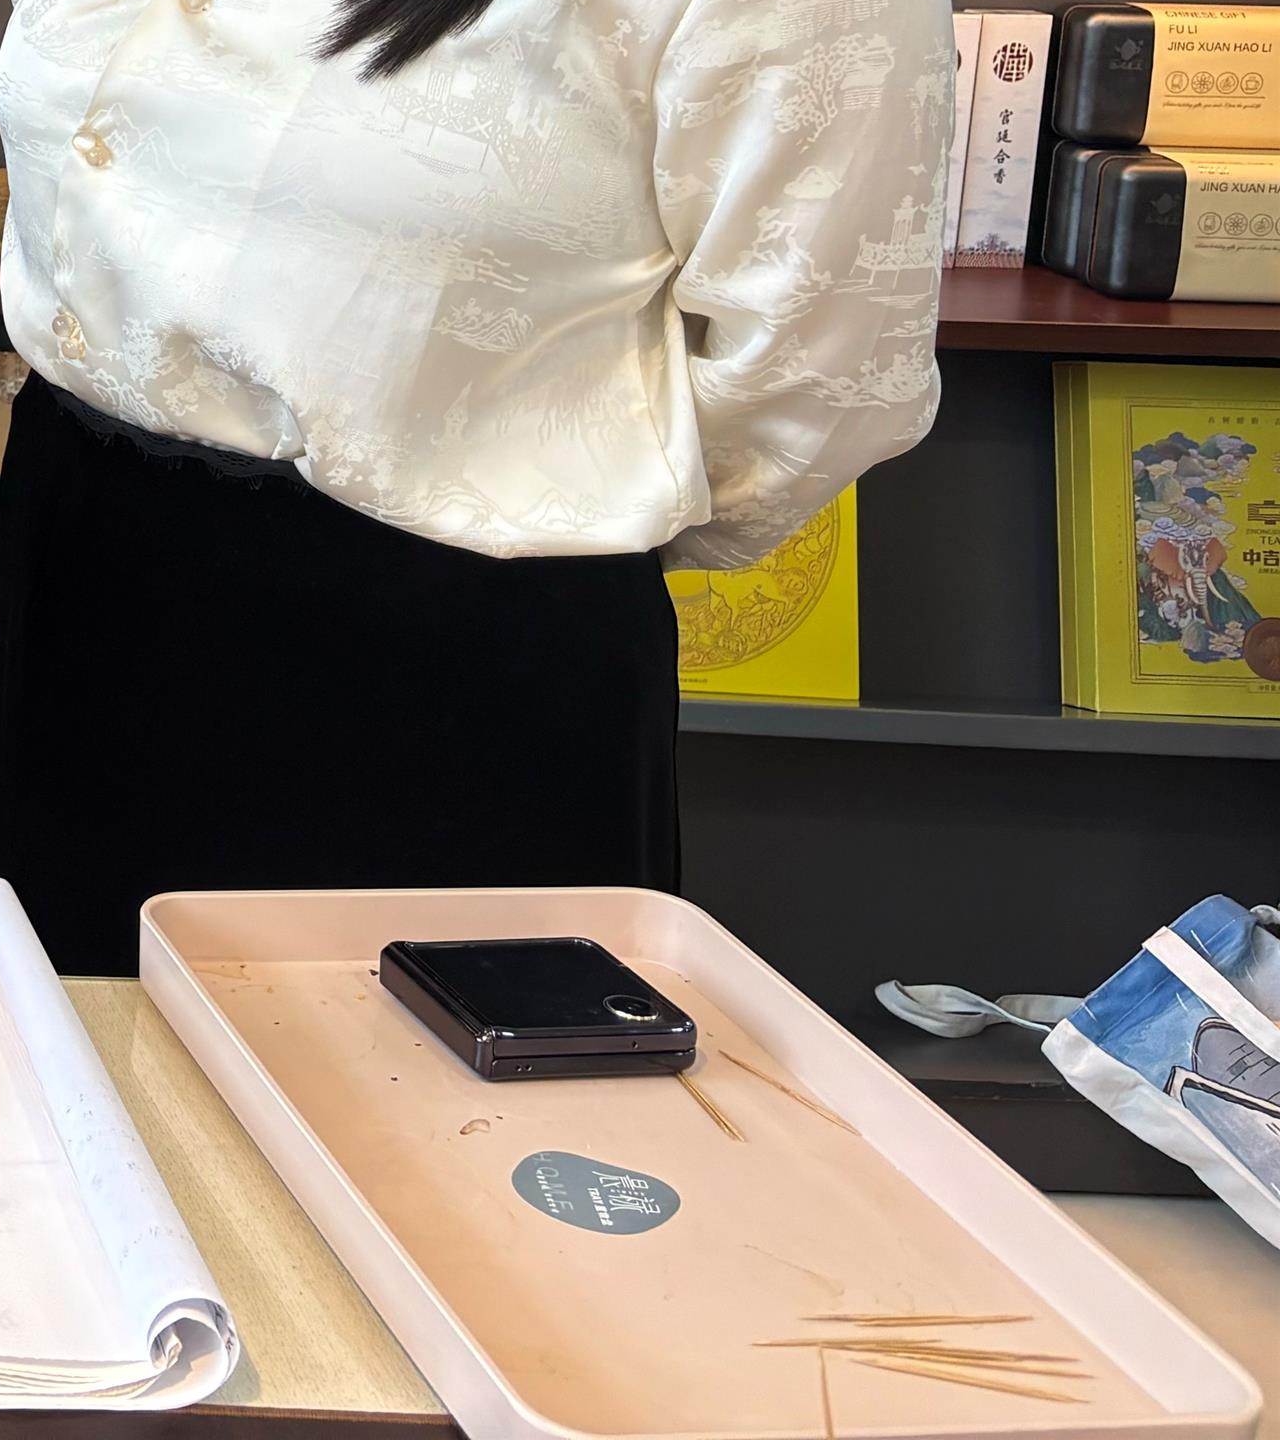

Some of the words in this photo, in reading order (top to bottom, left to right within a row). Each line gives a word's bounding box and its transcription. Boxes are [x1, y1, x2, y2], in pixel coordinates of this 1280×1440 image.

[1169, 24, 1185, 35] FU
[1187, 24, 1198, 35] LI
[1167, 42, 1194, 52] JING
[1197, 42, 1230, 52] XUAN
[1233, 43, 1260, 53] HAO
[1261, 43, 1272, 53] LI
[1200, 182, 1228, 192] JING
[1231, 182, 1264, 193] XUAN
